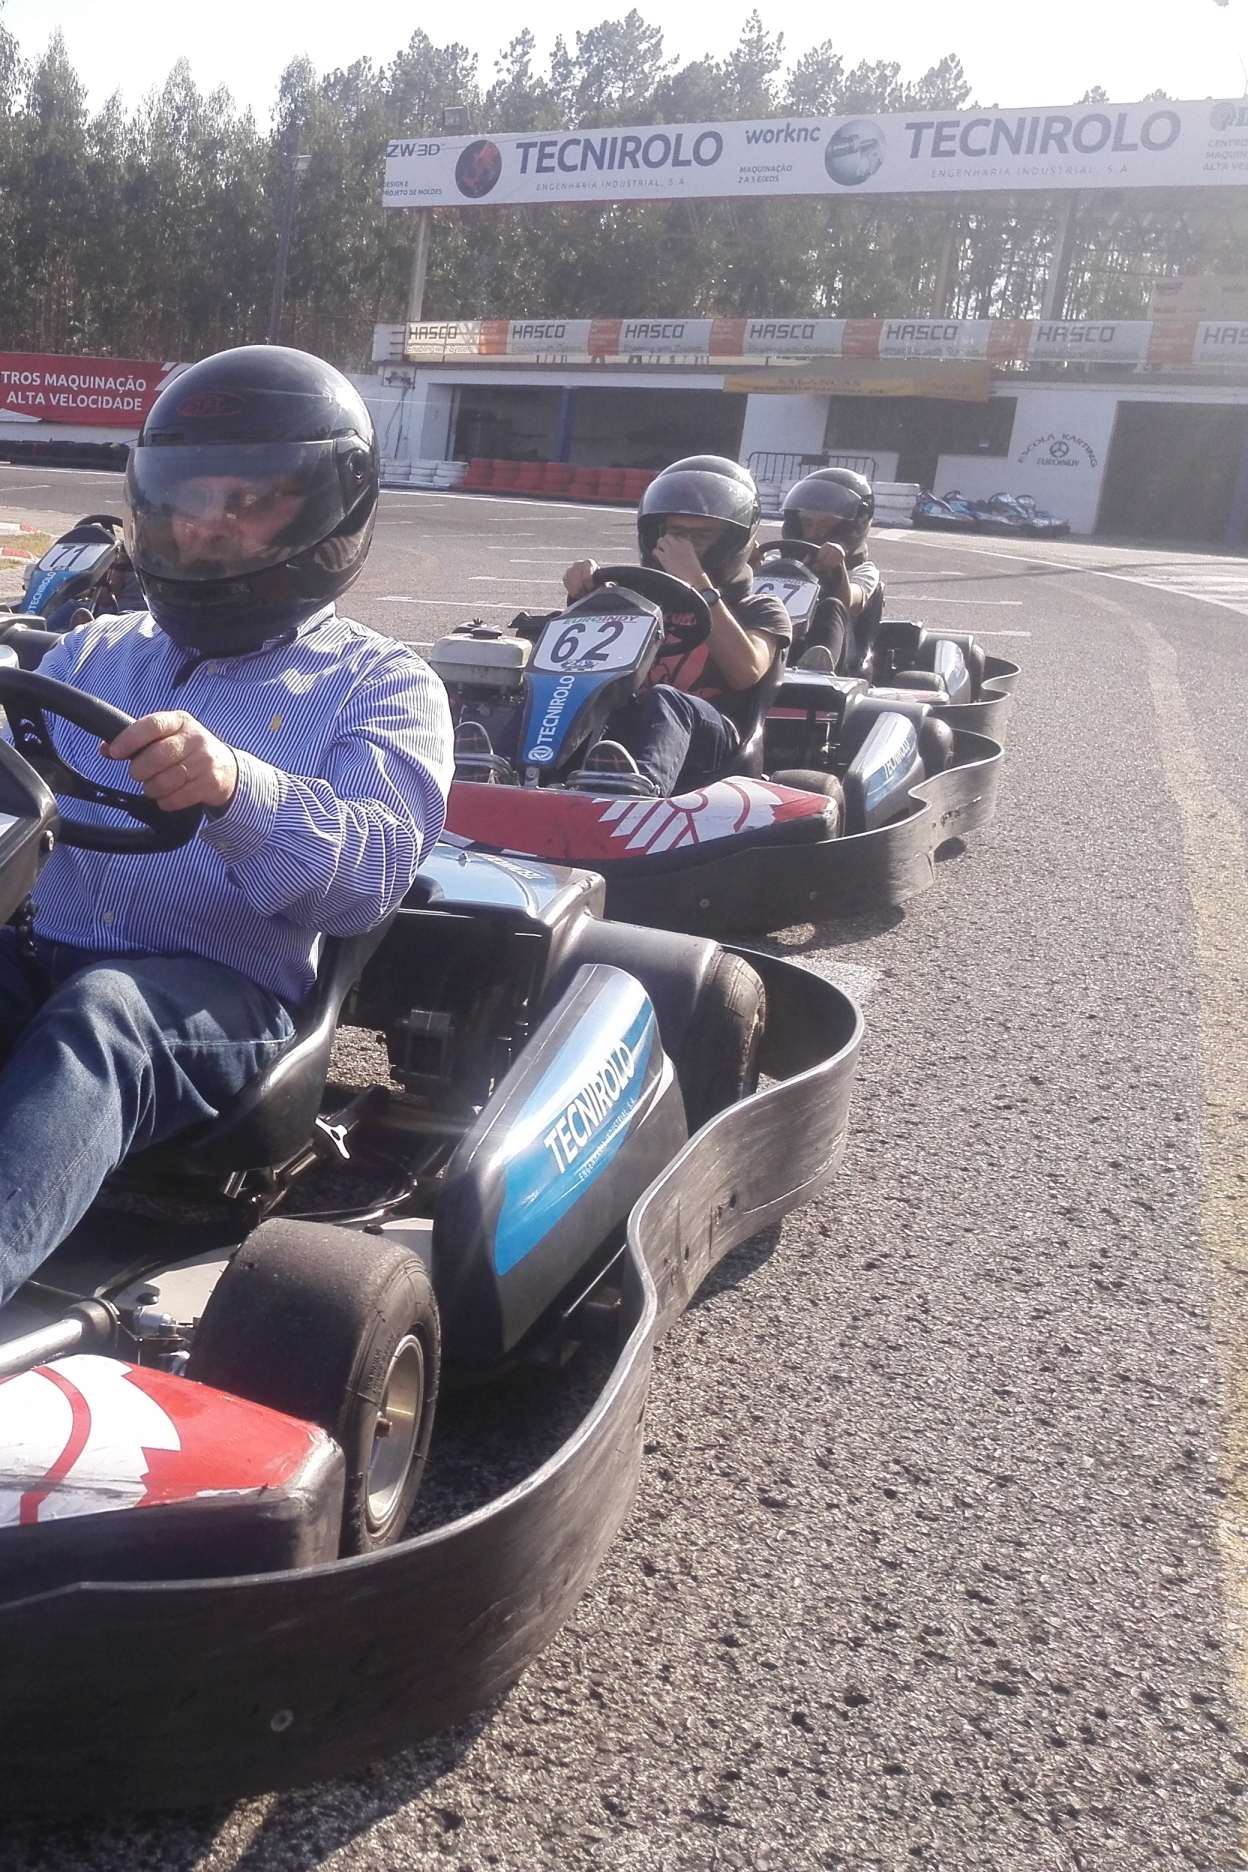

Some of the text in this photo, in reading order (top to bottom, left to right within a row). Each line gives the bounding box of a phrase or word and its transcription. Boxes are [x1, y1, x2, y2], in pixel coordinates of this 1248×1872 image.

[905, 111, 1182, 159] TECNIROLO
[387, 143, 441, 158] ZW3D
[516, 130, 723, 174] TECNIROLO
[536, 180, 598, 192] ENGENHARIA
[409, 325, 457, 340] HASCO
[512, 324, 566, 339] HASCO
[625, 324, 685, 339] HASCO
[750, 324, 815, 340] HASCO
[886, 325, 959, 341] HASCO
[1036, 326, 1115, 343] HASCO
[44, 373, 146, 393] MAQUINAÇÃO
[6, 391, 143, 411] ALTA VELOCIDADE
[50, 544, 90, 568] 71
[550, 620, 624, 664] 62
[537, 675, 576, 744] TECNIROLO
[544, 1039, 636, 1174] TECNIROLO
